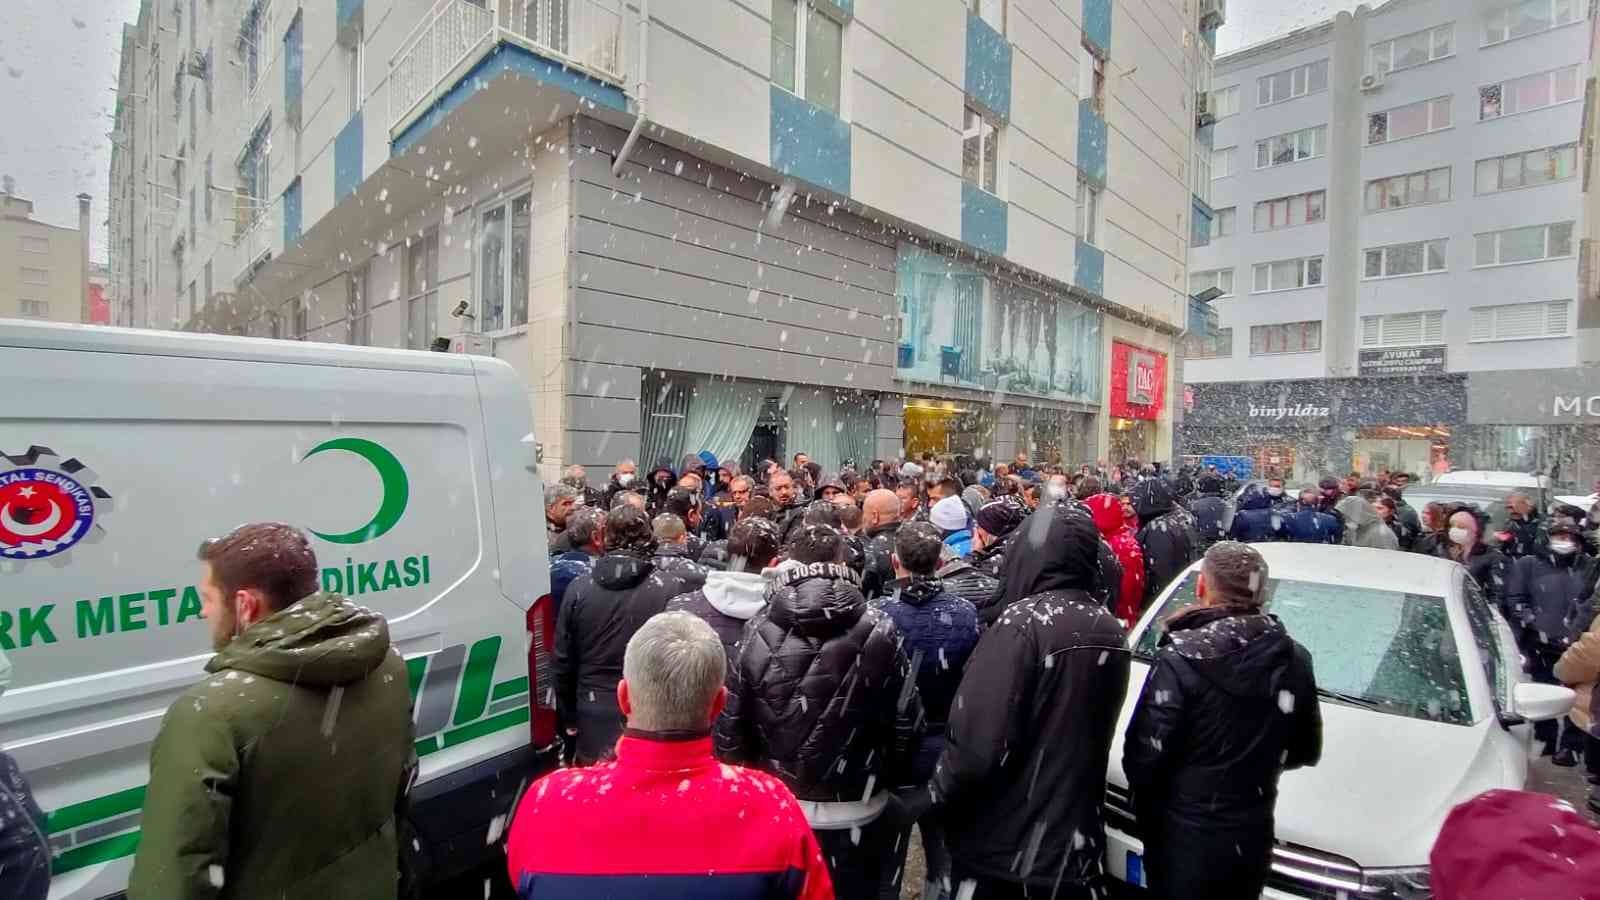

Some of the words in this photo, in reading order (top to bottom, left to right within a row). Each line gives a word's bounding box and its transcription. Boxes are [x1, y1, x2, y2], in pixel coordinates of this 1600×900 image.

[0, 472, 30, 487] TAL
[792, 562, 825, 580] JUST
[0, 604, 57, 650] RK
[76, 585, 207, 639] META
[322, 556, 430, 595] DİKASI
